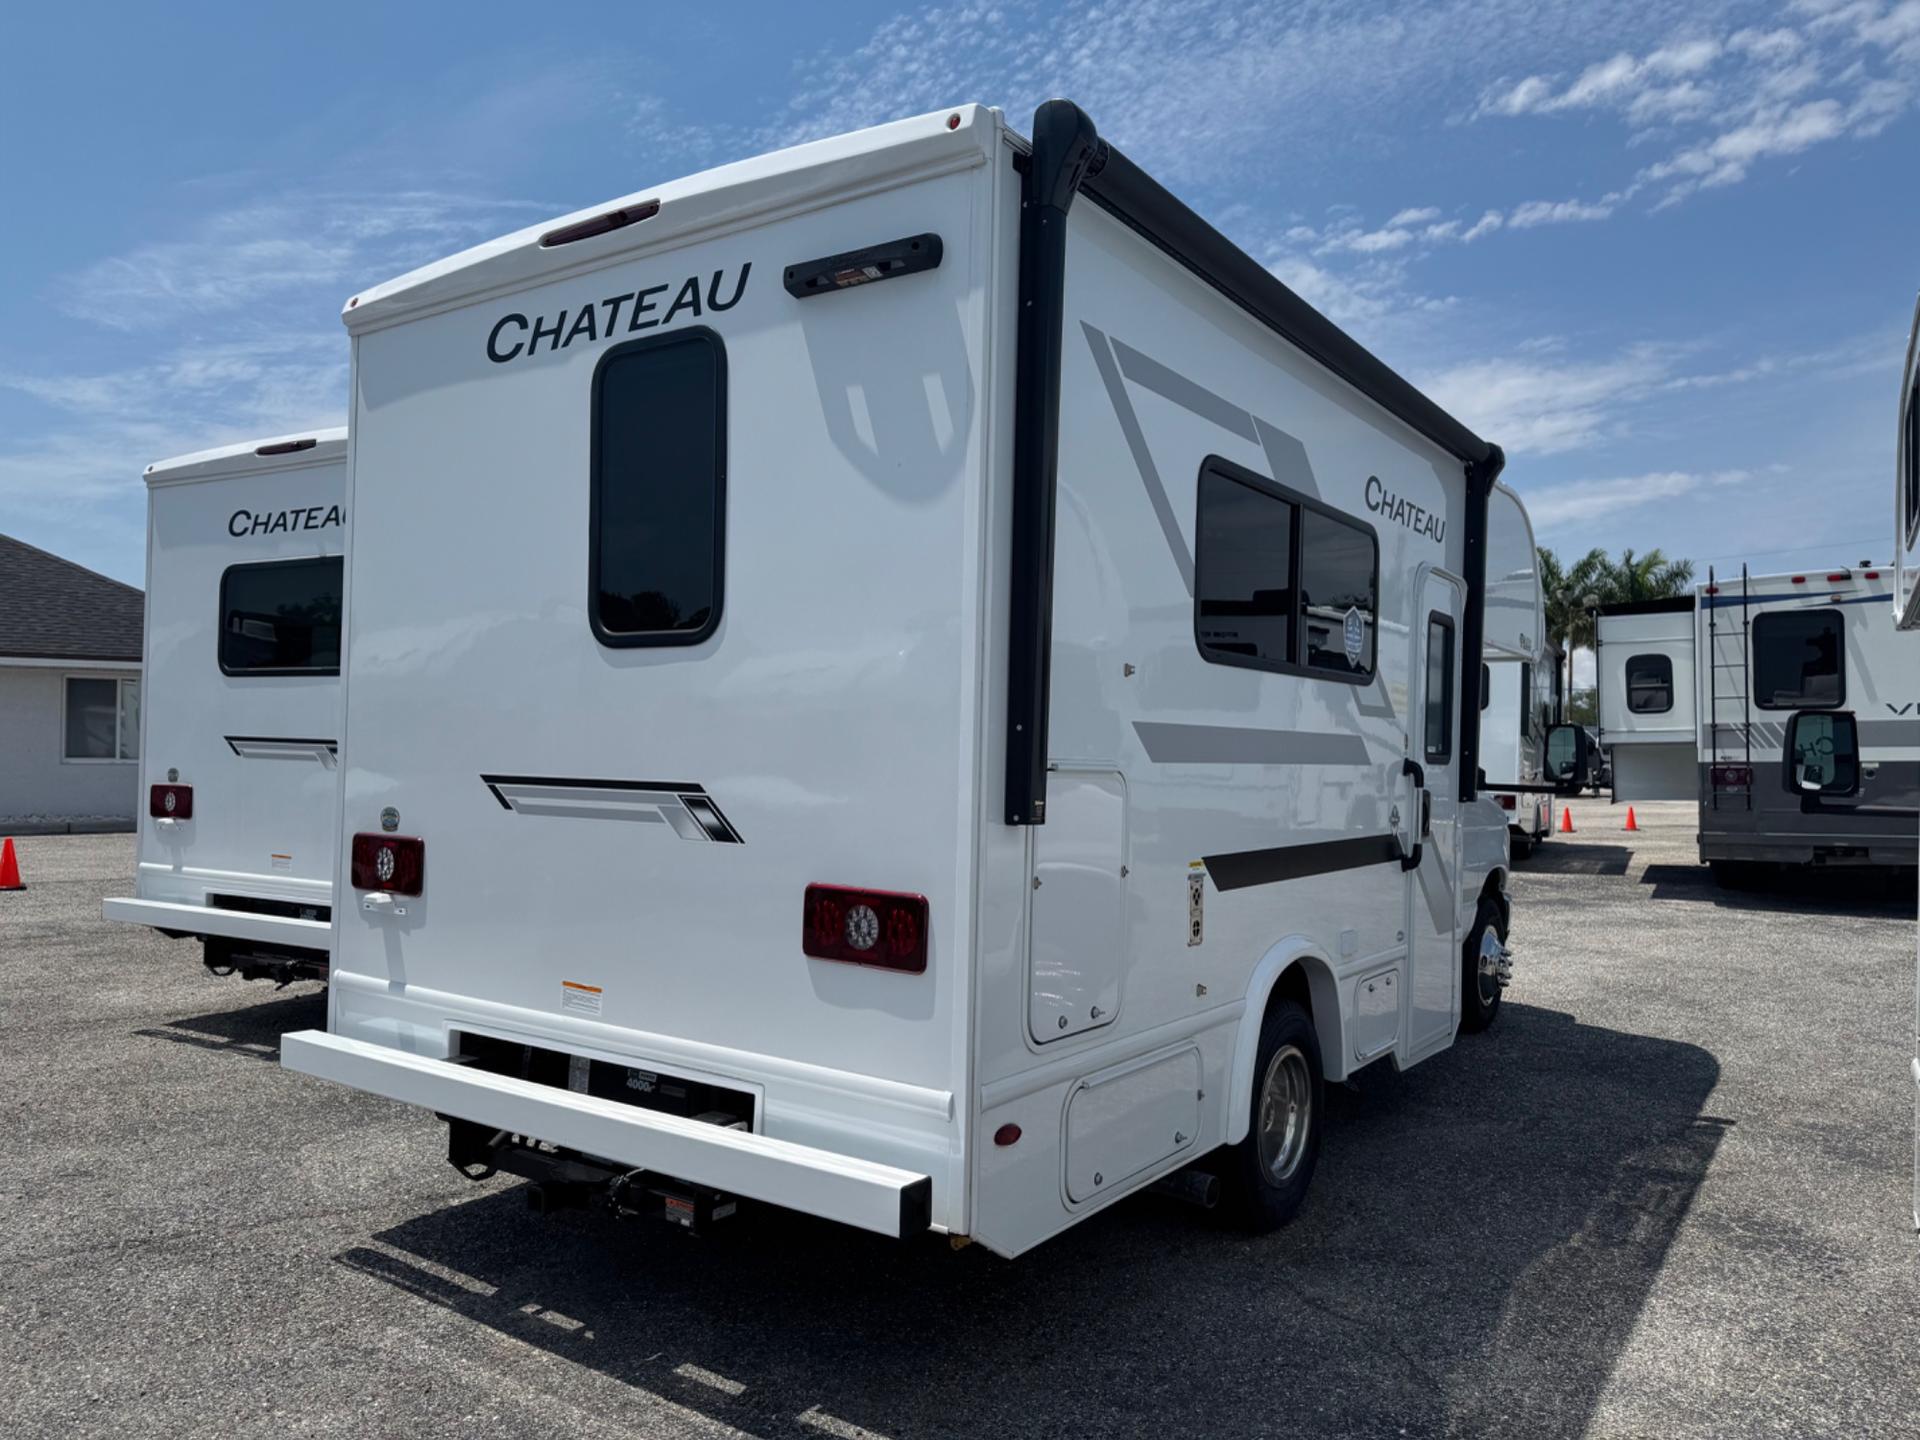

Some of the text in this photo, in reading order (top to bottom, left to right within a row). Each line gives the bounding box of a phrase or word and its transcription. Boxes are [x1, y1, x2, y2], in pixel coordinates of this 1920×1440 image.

[486, 262, 752, 363] CHATEAU
[228, 504, 346, 537] CHATEA
[1365, 475, 1446, 543] CHATEAU
[1885, 703, 1920, 715] V
